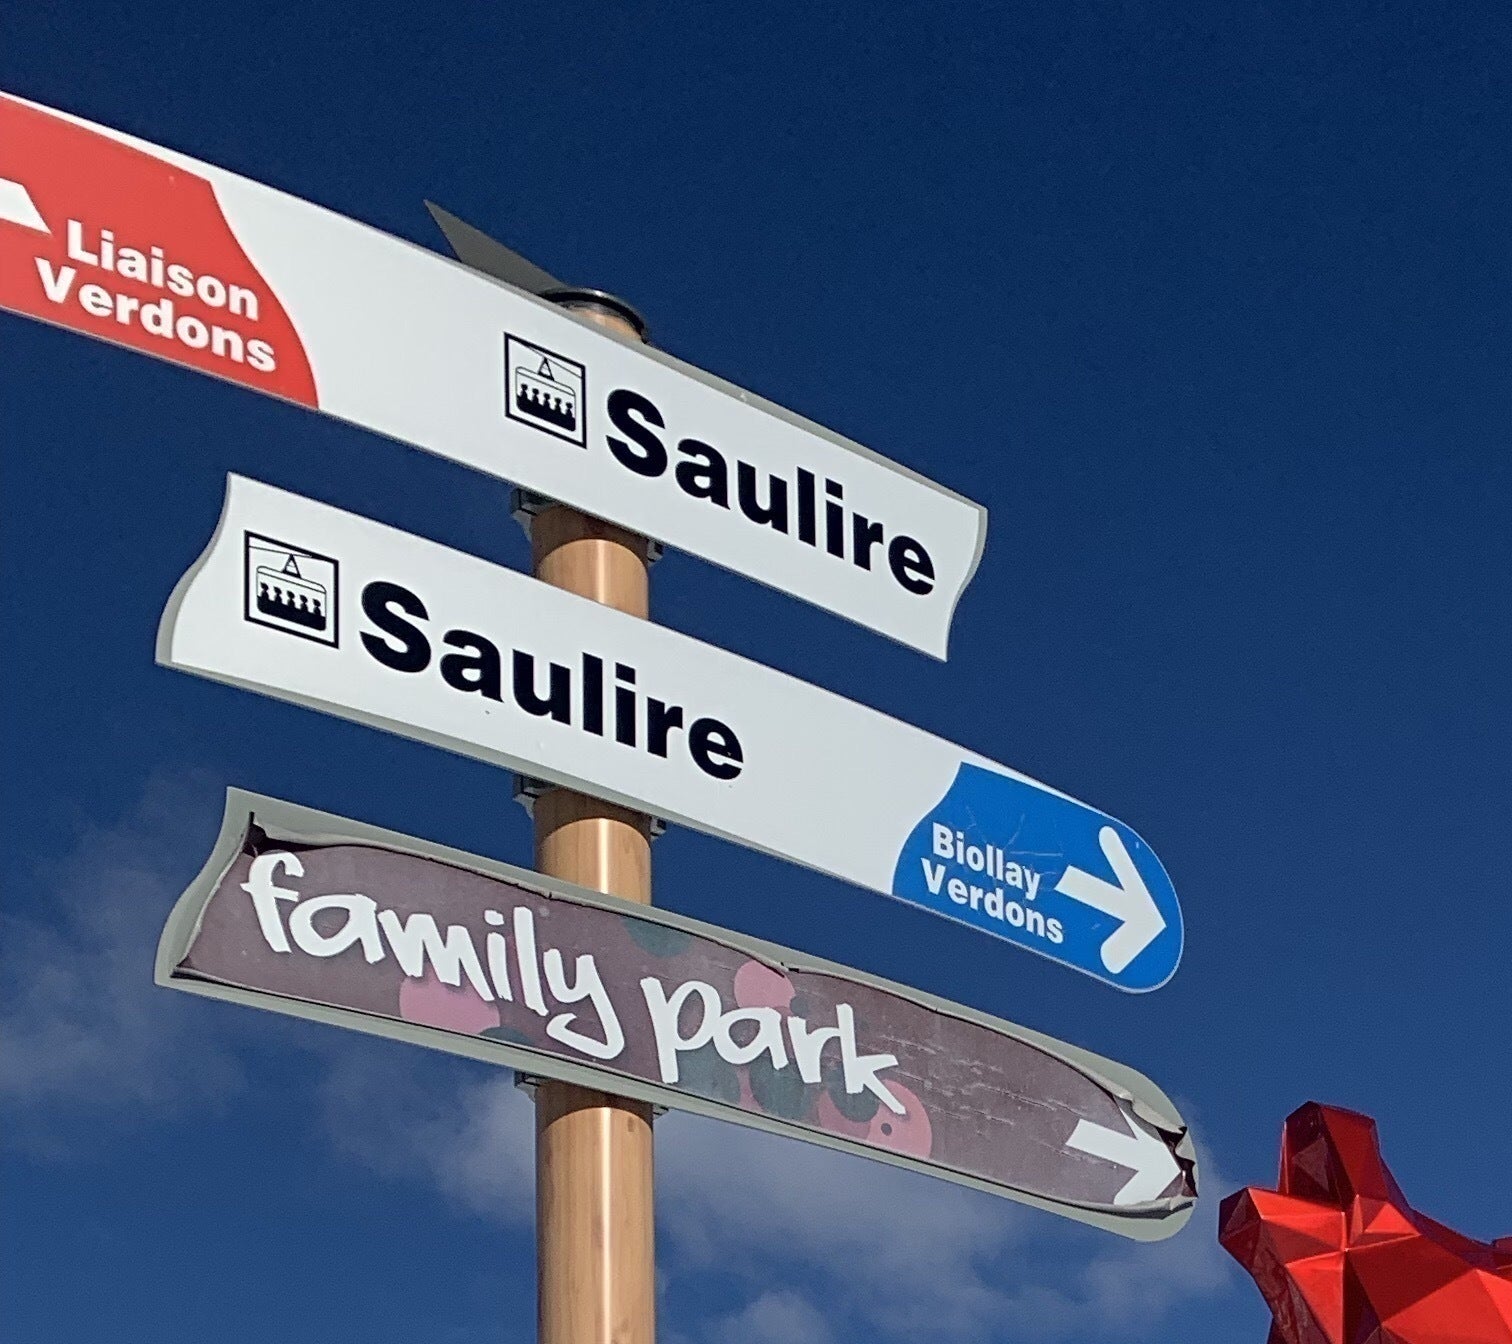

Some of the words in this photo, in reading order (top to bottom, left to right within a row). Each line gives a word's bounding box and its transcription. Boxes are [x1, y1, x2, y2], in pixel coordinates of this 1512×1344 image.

[34, 256, 277, 374] Verdons
[66, 218, 259, 322] Liaison
[605, 389, 936, 597] Saulire
[359, 580, 745, 781] Saulire
[920, 857, 1065, 945] Verdons
[932, 821, 1041, 902] Biollay
[241, 851, 625, 1060] family
[639, 976, 907, 1115] park
